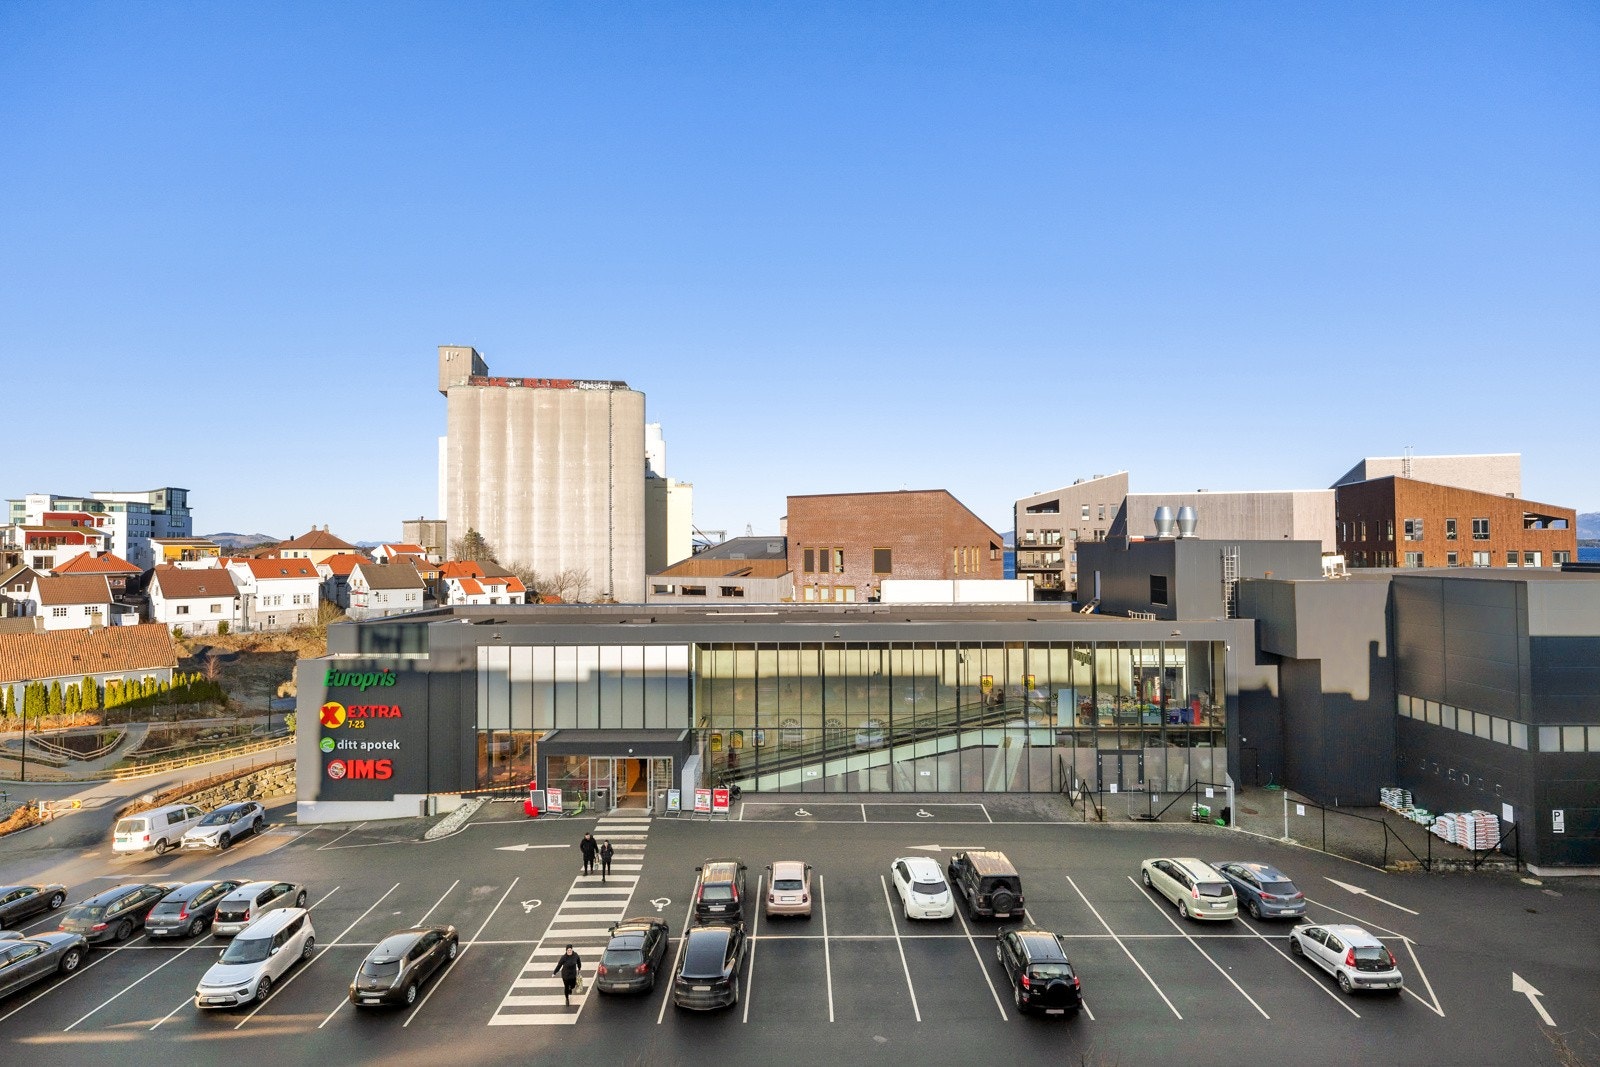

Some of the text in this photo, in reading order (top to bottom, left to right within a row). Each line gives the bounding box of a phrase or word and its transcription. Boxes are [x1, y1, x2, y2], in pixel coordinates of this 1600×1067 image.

[323, 668, 396, 692] Europris
[347, 705, 402, 718] EXTRA
[348, 720, 365, 729] 7-23
[337, 740, 400, 751] ditt apotek
[347, 760, 393, 779] IMS
[1554, 811, 1561, 822] P
